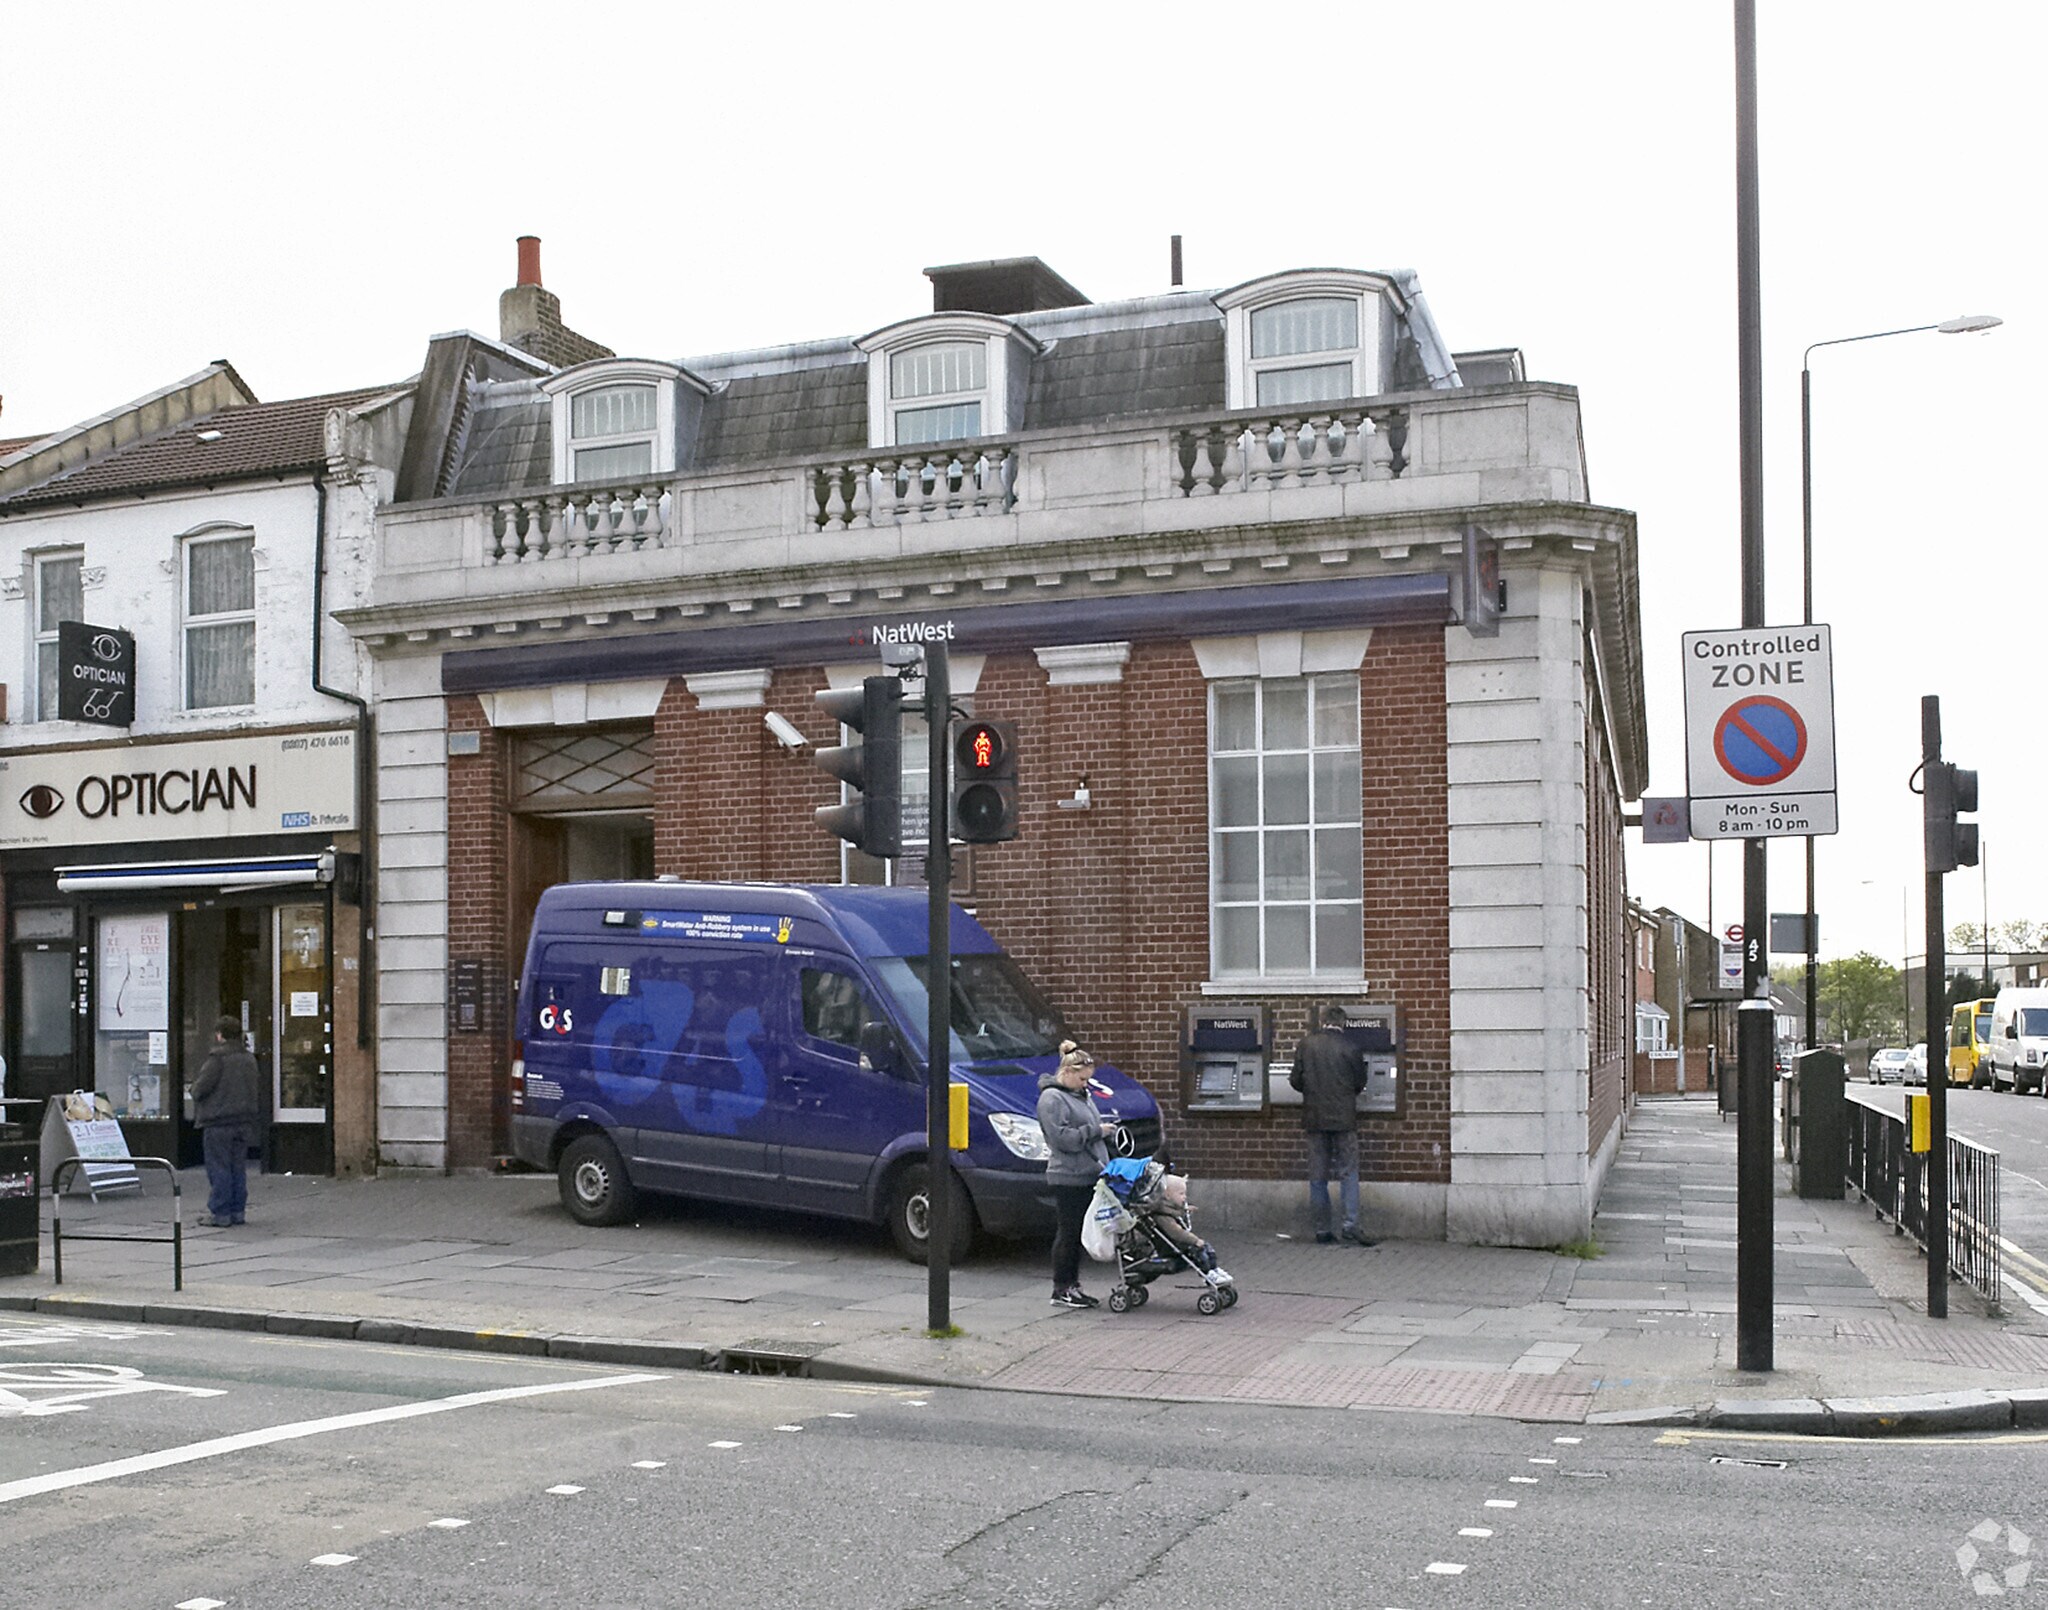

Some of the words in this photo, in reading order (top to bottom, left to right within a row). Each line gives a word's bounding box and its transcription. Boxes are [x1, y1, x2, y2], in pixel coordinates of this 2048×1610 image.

[872, 620, 955, 645] NatWest
[1694, 634, 1820, 658] Controlled
[73, 664, 126, 685] OPTICIAN
[1712, 661, 1805, 688] ZONE
[76, 764, 257, 819] OPTICIAN
[1725, 803, 1758, 816] Mon
[1770, 801, 1800, 814] Sun
[283, 812, 310, 828] NHS
[1719, 820, 1728, 832] 8
[1732, 821, 1753, 832] am
[1766, 819, 1783, 830] 10
[1786, 818, 1809, 831] pm
[702, 914, 731, 923] WARNING
[662, 920, 694, 929] SmartWater
[731, 924, 752, 932] system
[141, 935, 160, 944] EYE
[1748, 938, 1759, 949] 4
[1748, 949, 1758, 962] 5
[540, 1005, 573, 1035] G4S
[1213, 1020, 1248, 1029] NatWest
[1345, 1019, 1381, 1028] NatWest
